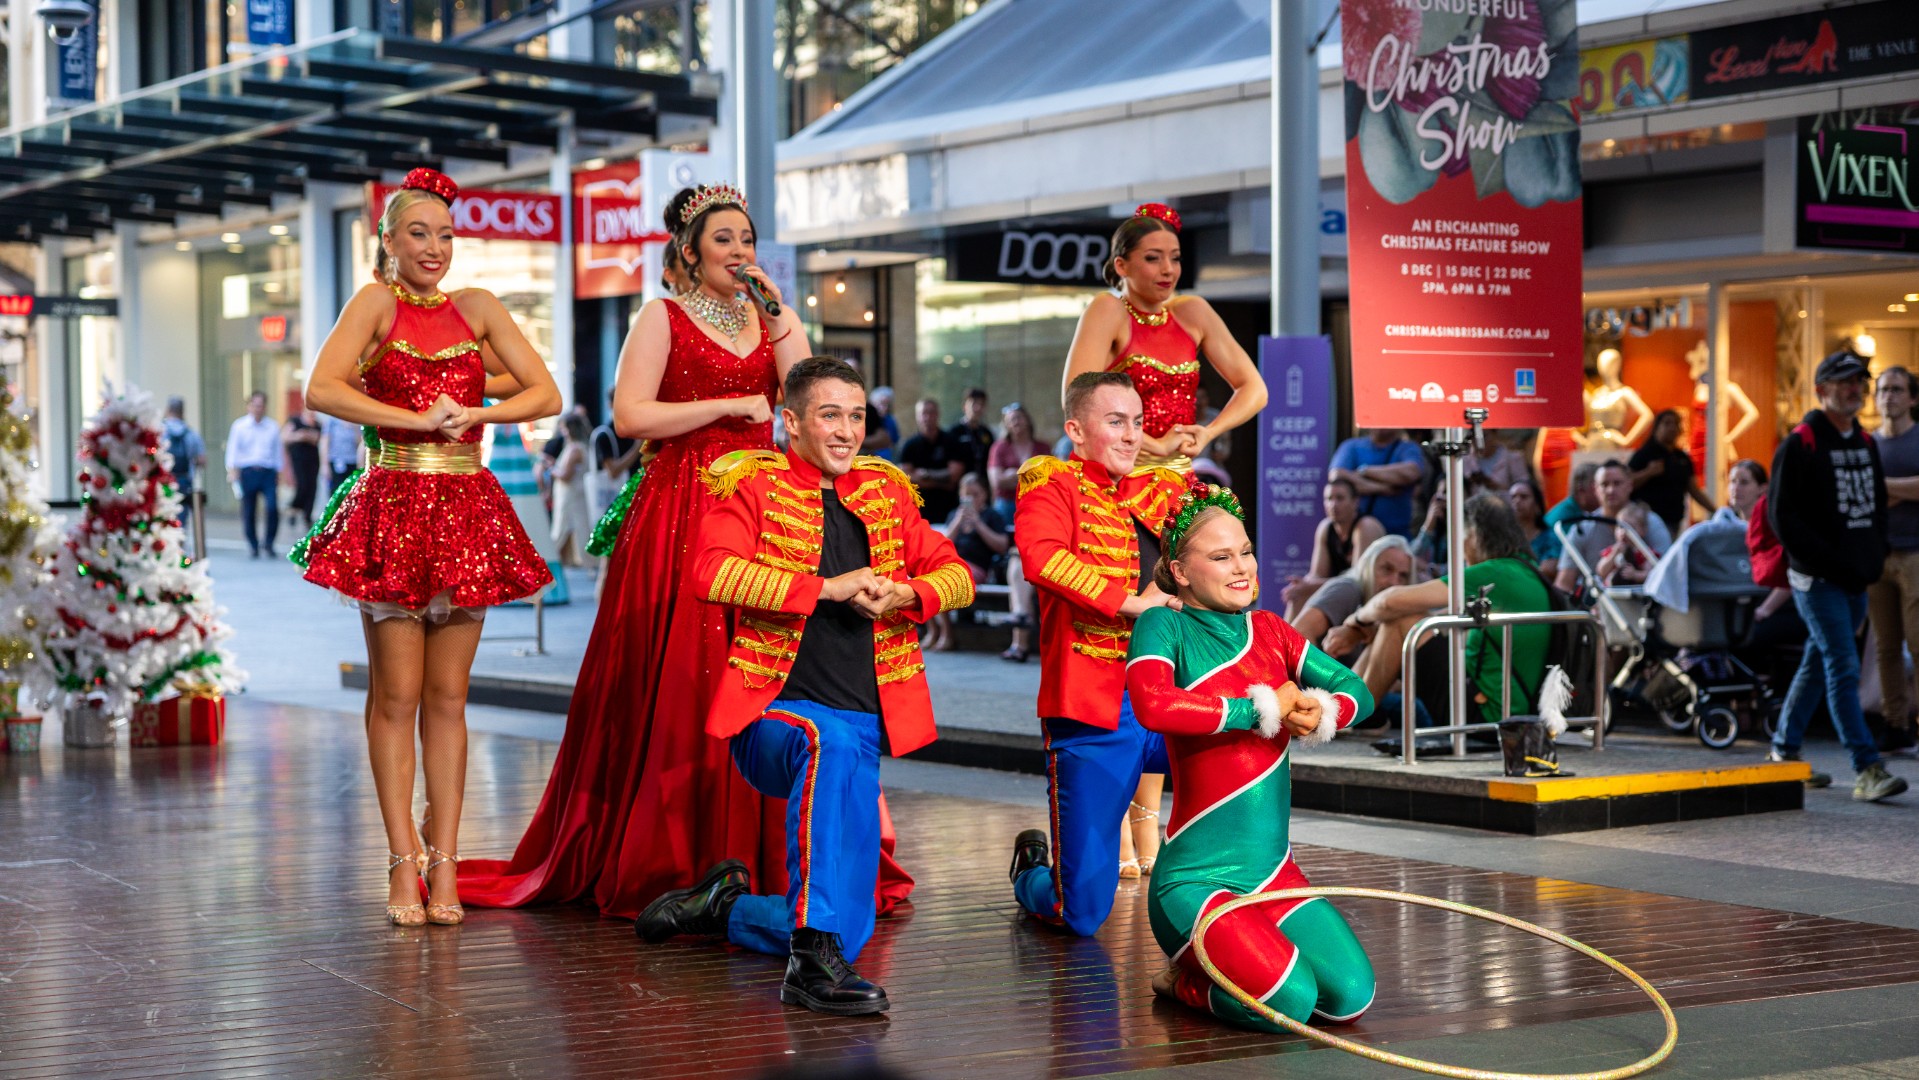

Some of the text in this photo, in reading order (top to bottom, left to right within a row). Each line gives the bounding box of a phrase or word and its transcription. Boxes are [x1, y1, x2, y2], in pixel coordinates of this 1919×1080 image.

[1848, 38, 1918, 62] THE VENUE
[1366, 33, 1557, 113] Christmas
[1416, 97, 1524, 170] Show
[1807, 139, 1919, 213] VIXEN
[1411, 219, 1520, 237] AN ENCHANTING
[1381, 234, 1550, 255] CHRISTMAS FEATURE SHOW
[998, 231, 1108, 279] DOOR
[1401, 263, 1409, 275] 8
[1411, 264, 1433, 276] DEC
[1445, 265, 1457, 277] 15
[1460, 266, 1482, 278] DEC
[1493, 267, 1507, 279] 22
[1510, 268, 1532, 280] DEC
[1422, 282, 1512, 296] 5PM, 6PM & 7PM
[1384, 324, 1550, 340] CHRISTMASINBRISBANE.COM.AU
[1273, 416, 1316, 433] KEEP
[1270, 434, 1318, 450] CALM
[1282, 455, 1306, 464] AND
[1266, 467, 1321, 482] POCKET
[1270, 482, 1317, 498] YOUR
[1272, 501, 1314, 516] VAPE
